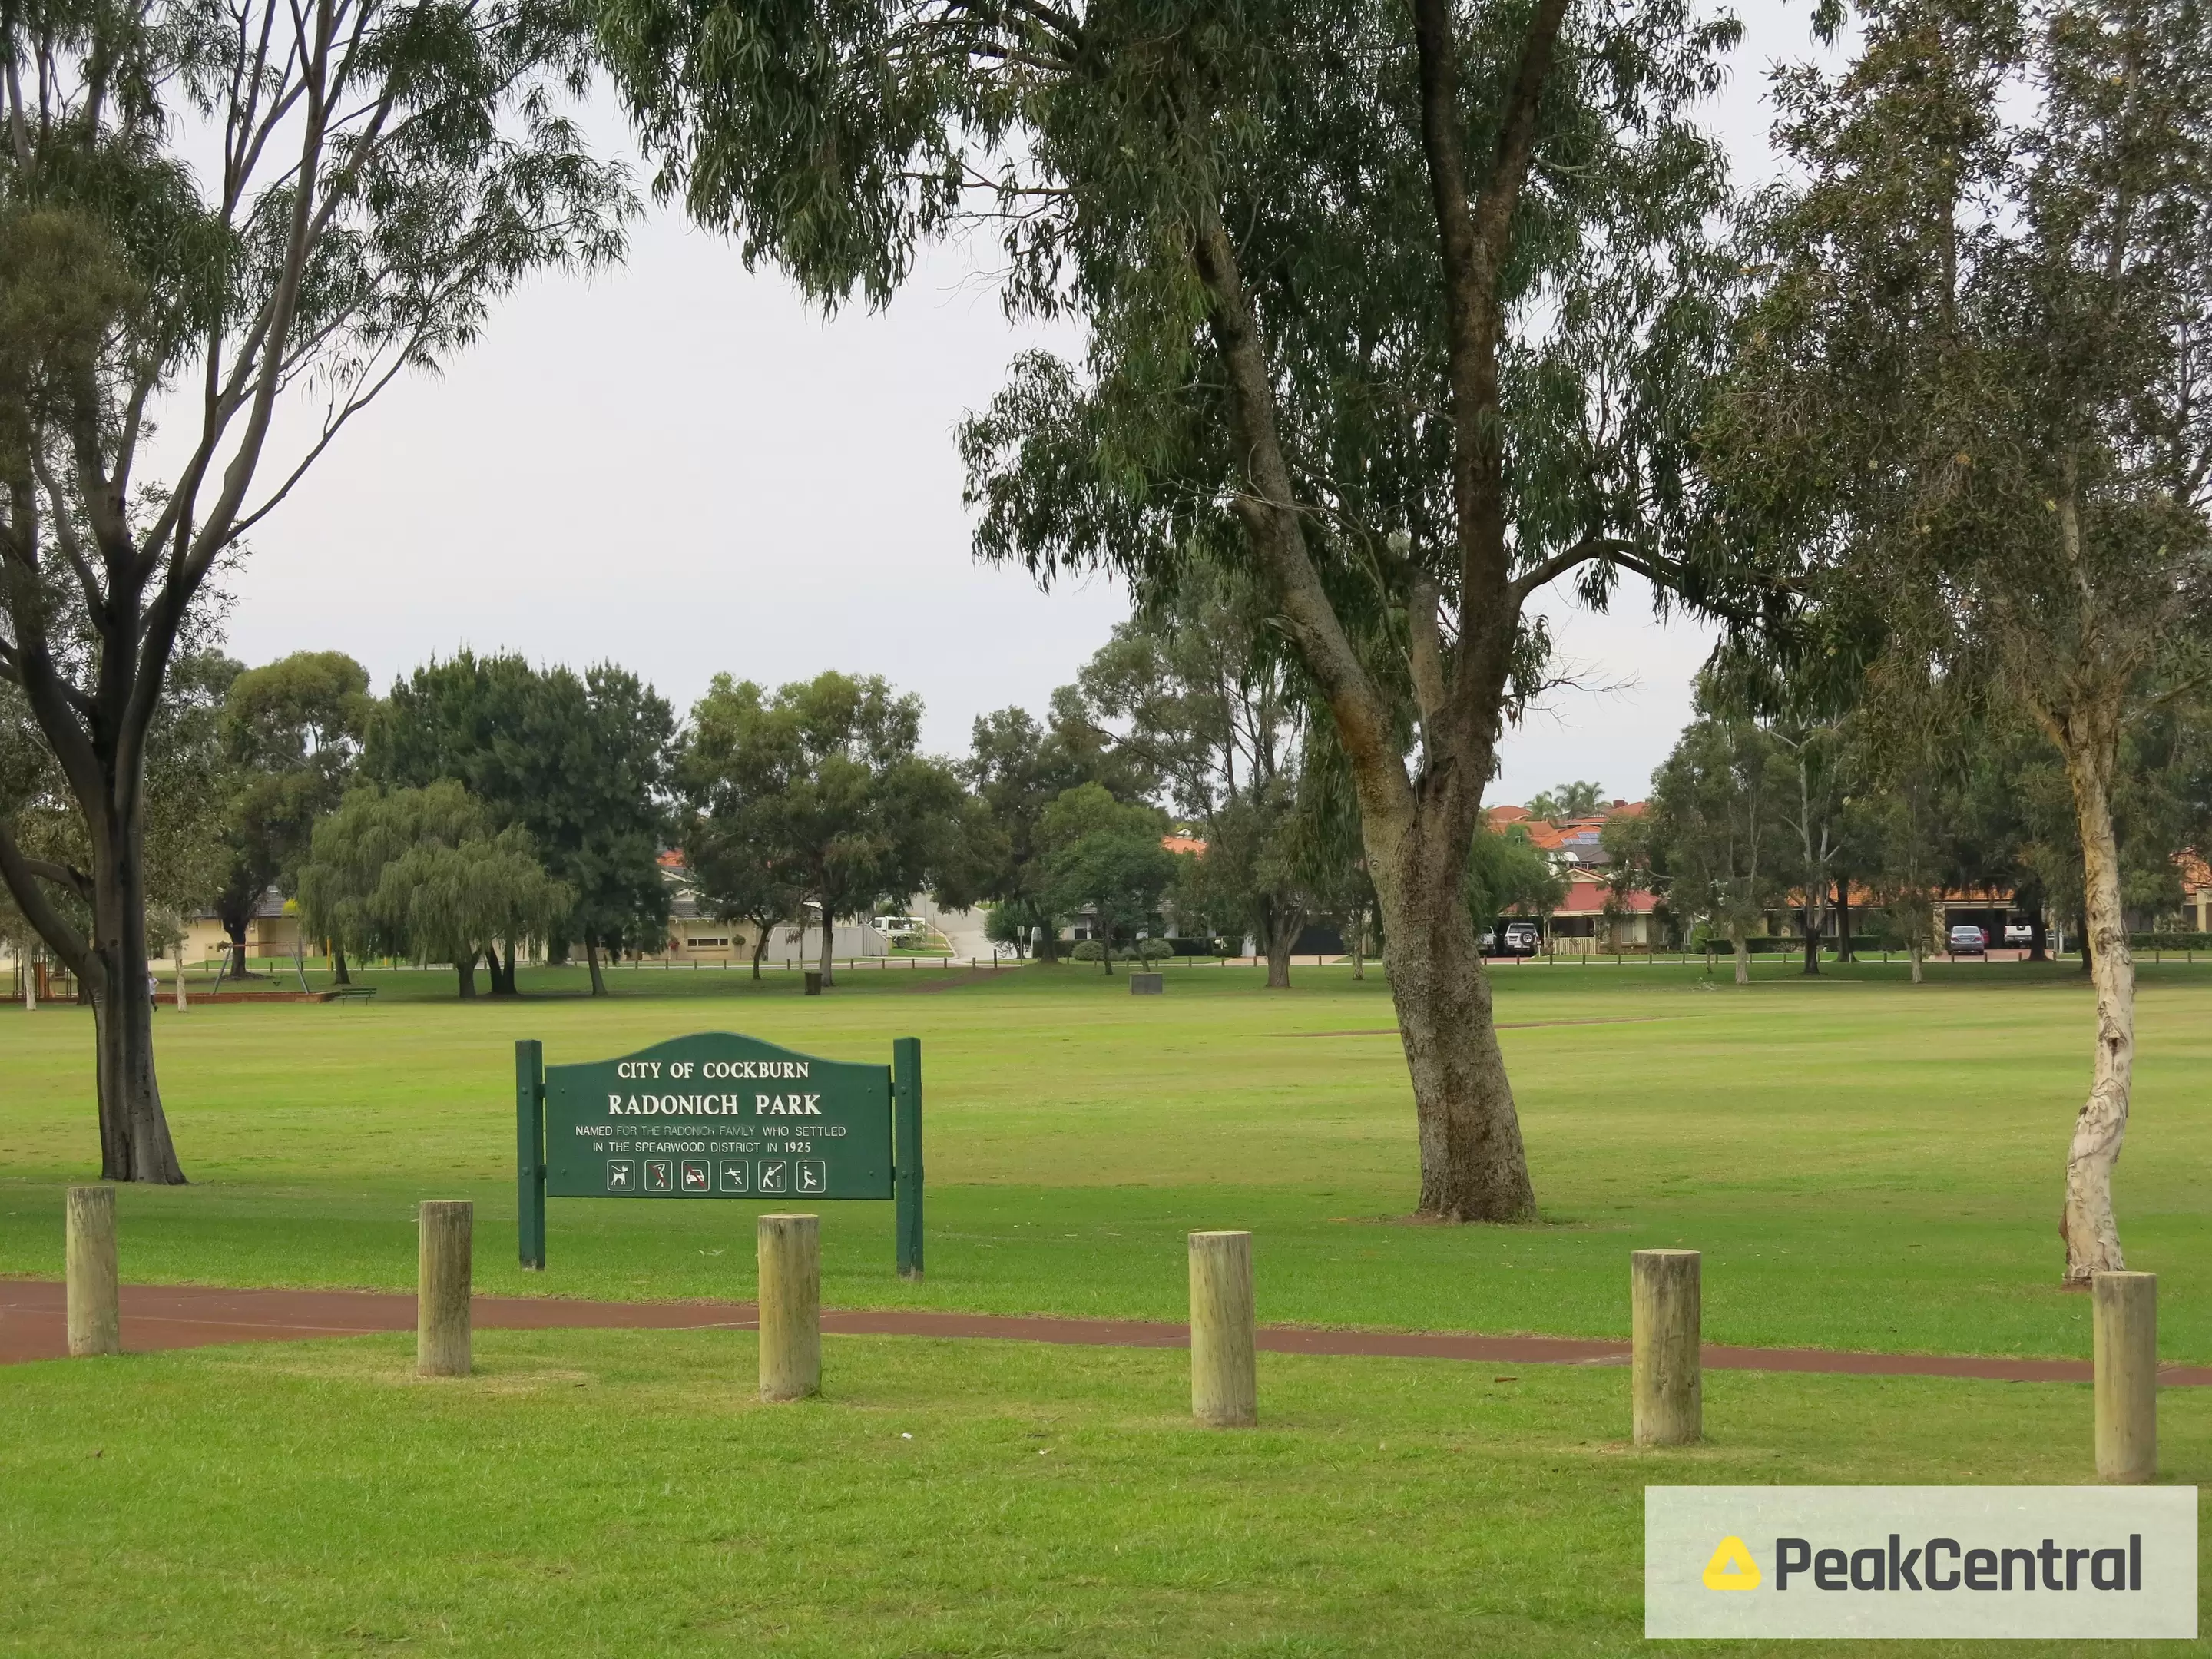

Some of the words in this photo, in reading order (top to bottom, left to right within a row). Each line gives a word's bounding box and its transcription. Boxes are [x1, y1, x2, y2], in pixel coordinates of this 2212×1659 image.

[618, 1062, 661, 1078] CITY
[670, 1062, 694, 1078] OF
[703, 1061, 809, 1078] COCKBURN
[608, 1094, 738, 1115] RADONICH
[755, 1094, 822, 1115] PARK
[575, 1125, 613, 1136] NAMED
[616, 1125, 637, 1136] FOR
[641, 1125, 661, 1136] THE
[664, 1125, 715, 1136] RADONICH
[719, 1125, 756, 1137] FAMILY
[762, 1126, 790, 1137] WHO
[795, 1126, 846, 1137] SETTLED
[592, 1141, 604, 1152] IN
[609, 1141, 630, 1152] THE
[635, 1141, 706, 1153] SPEARWOOD
[710, 1142, 760, 1153] DISTRICT
[767, 1142, 778, 1153] IN
[784, 1141, 812, 1153] 1925
